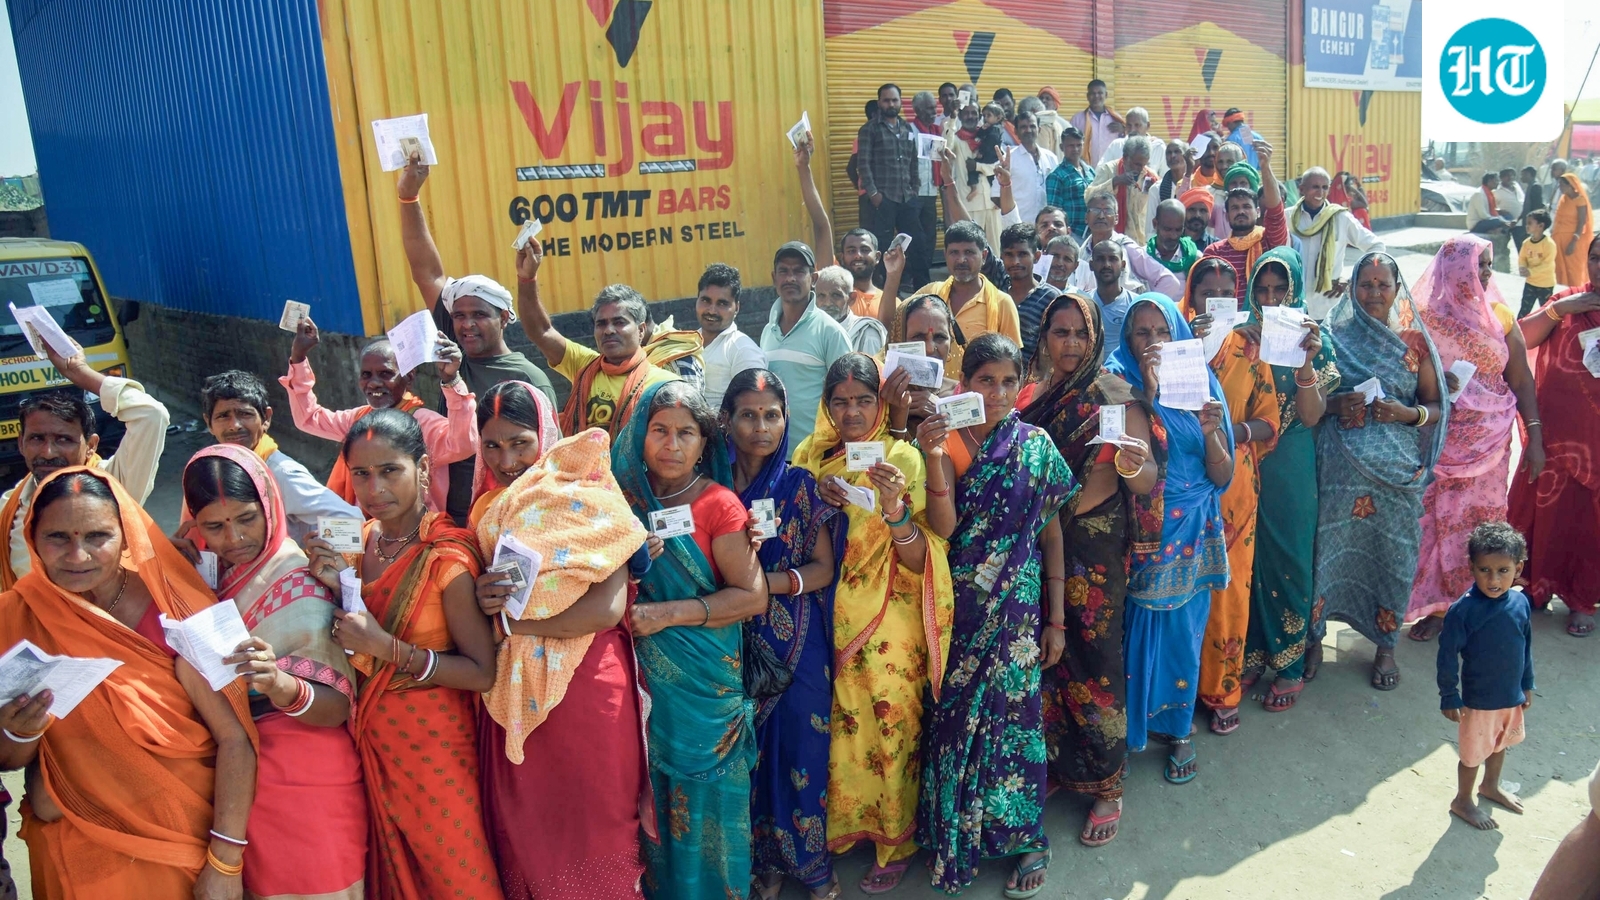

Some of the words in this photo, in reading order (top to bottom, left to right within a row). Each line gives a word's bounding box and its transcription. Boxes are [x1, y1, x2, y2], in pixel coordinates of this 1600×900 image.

[1311, 7, 1364, 40] BANGUR
[1320, 39, 1355, 56] CEMENT
[509, 79, 734, 177] Vijay
[1329, 134, 1392, 182] Vijay
[657, 185, 731, 215] BARS
[541, 237, 570, 256] HE
[581, 226, 673, 255] MODERN
[681, 221, 745, 242] STEEL
[1, 356, 38, 366] SCHOOL
[41, 367, 65, 381] VA
